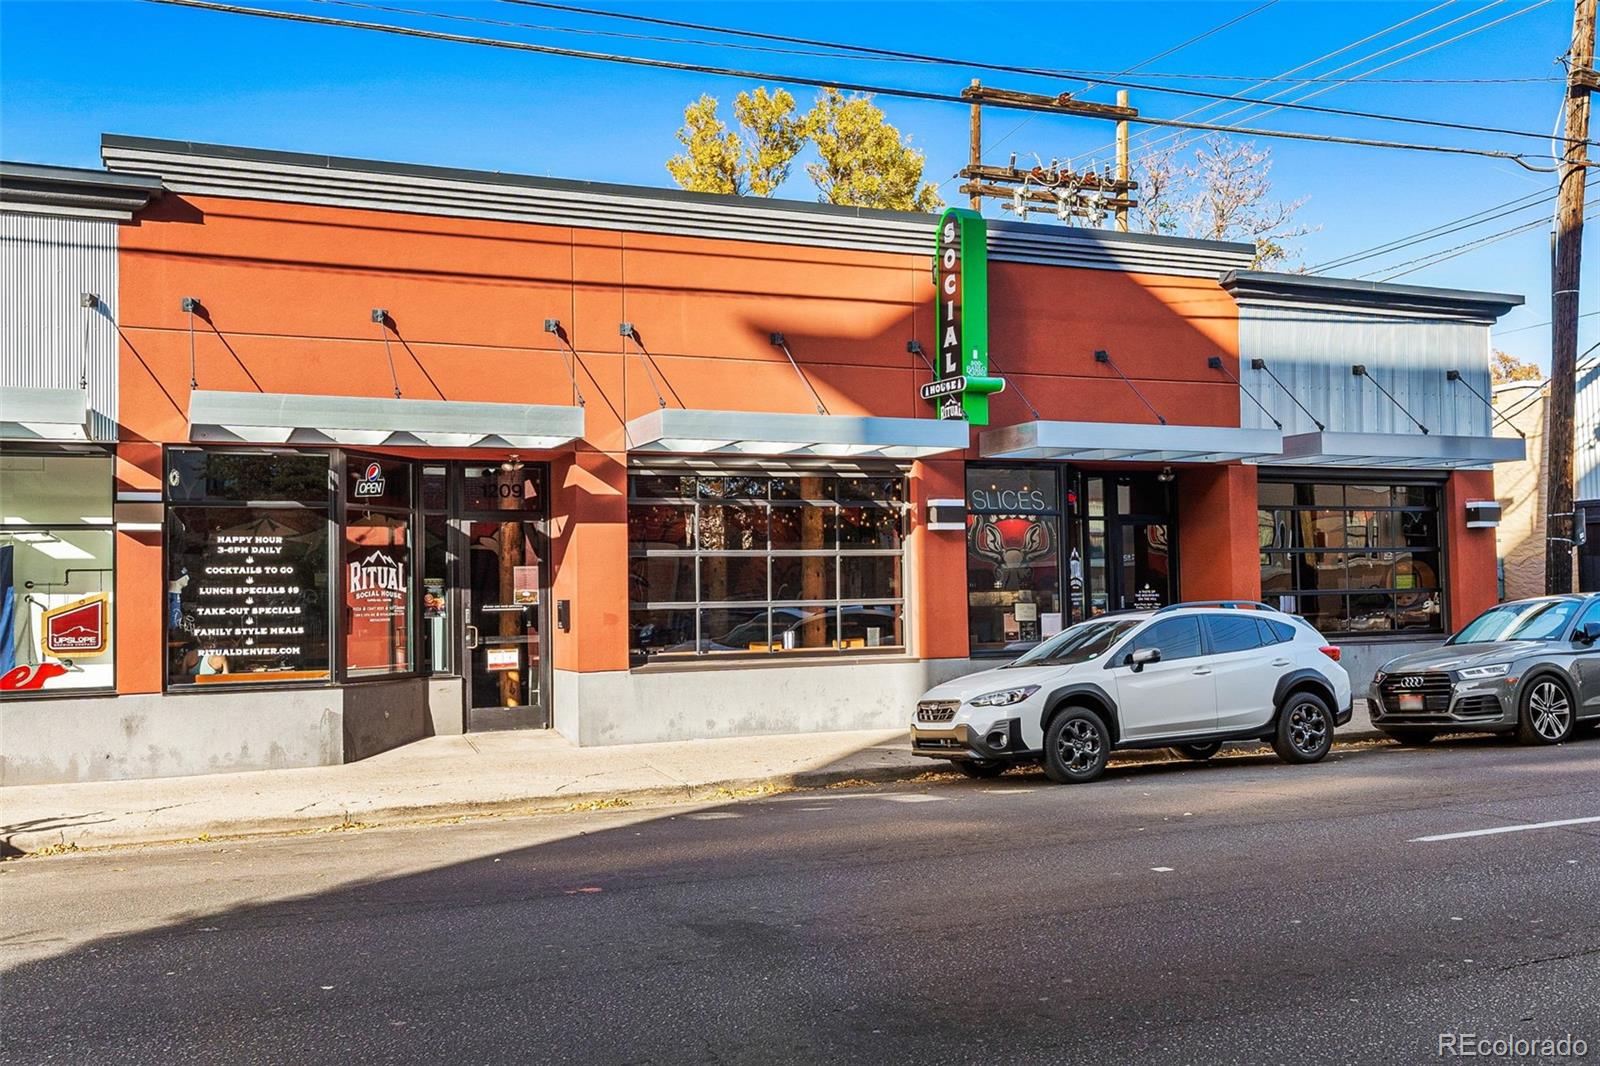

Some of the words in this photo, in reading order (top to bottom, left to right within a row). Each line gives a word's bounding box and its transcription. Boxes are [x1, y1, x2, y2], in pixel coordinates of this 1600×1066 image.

[943, 222, 958, 374] SOCIAL
[929, 380, 957, 396] HOUSE
[940, 402, 963, 420] RITUAL
[359, 482, 382, 494] OPEN
[482, 483, 522, 498] 1209
[972, 489, 1045, 511] SLICES
[217, 536, 253, 544] HAPPY
[255, 536, 283, 544] HOUR
[217, 546, 249, 554] 3-6PM
[251, 546, 282, 554] DAILY
[205, 566, 262, 574] COCKTAILS
[264, 566, 278, 574] TO
[280, 566, 294, 574] GO
[350, 561, 407, 593] RITUAL
[199, 587, 234, 595] LUNCH
[235, 586, 286, 594] SPECIALS
[287, 586, 300, 594] $9
[356, 591, 380, 600] SOCIAL
[381, 591, 402, 600] HOUSE
[197, 607, 250, 615] TAKE-OUT
[251, 606, 301, 614] SPECIALS
[193, 628, 232, 636] FAMILY
[234, 627, 268, 635] STYLE
[269, 626, 304, 634] MEALS
[197, 647, 301, 656] RITUALDENVER.COM
